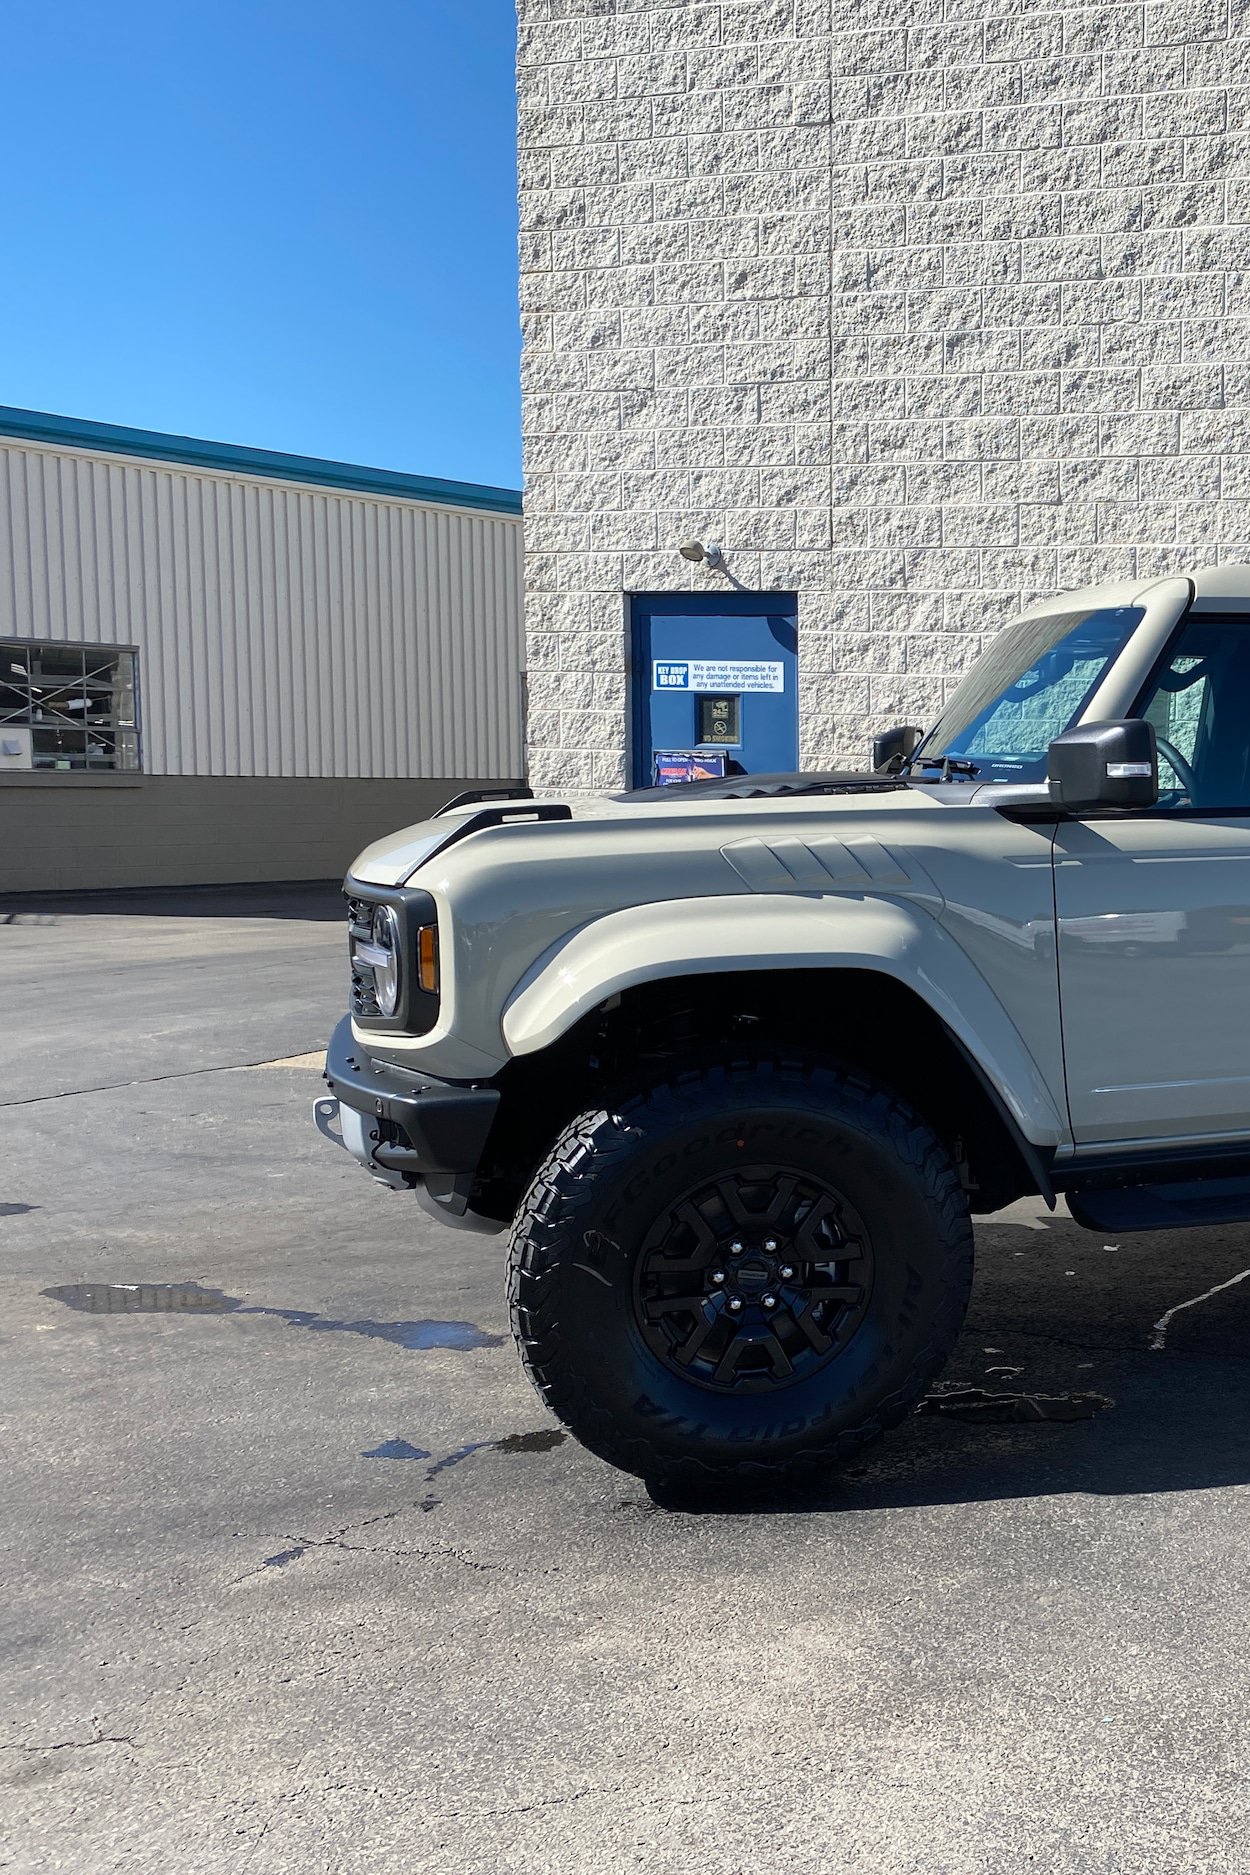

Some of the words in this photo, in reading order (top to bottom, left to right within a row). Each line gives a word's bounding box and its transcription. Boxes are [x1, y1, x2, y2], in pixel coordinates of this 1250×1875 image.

[657, 666, 669, 675] KEY
[670, 666, 688, 675] DROP
[729, 665, 766, 674] responsible
[768, 665, 778, 673] for
[659, 674, 685, 686] BOX
[692, 673, 704, 681] any
[706, 672, 731, 682] damage
[741, 673, 759, 681] items
[760, 673, 772, 681] left
[696, 681, 708, 689] any
[709, 680, 745, 688] unattended
[747, 681, 775, 689] vehicles.
